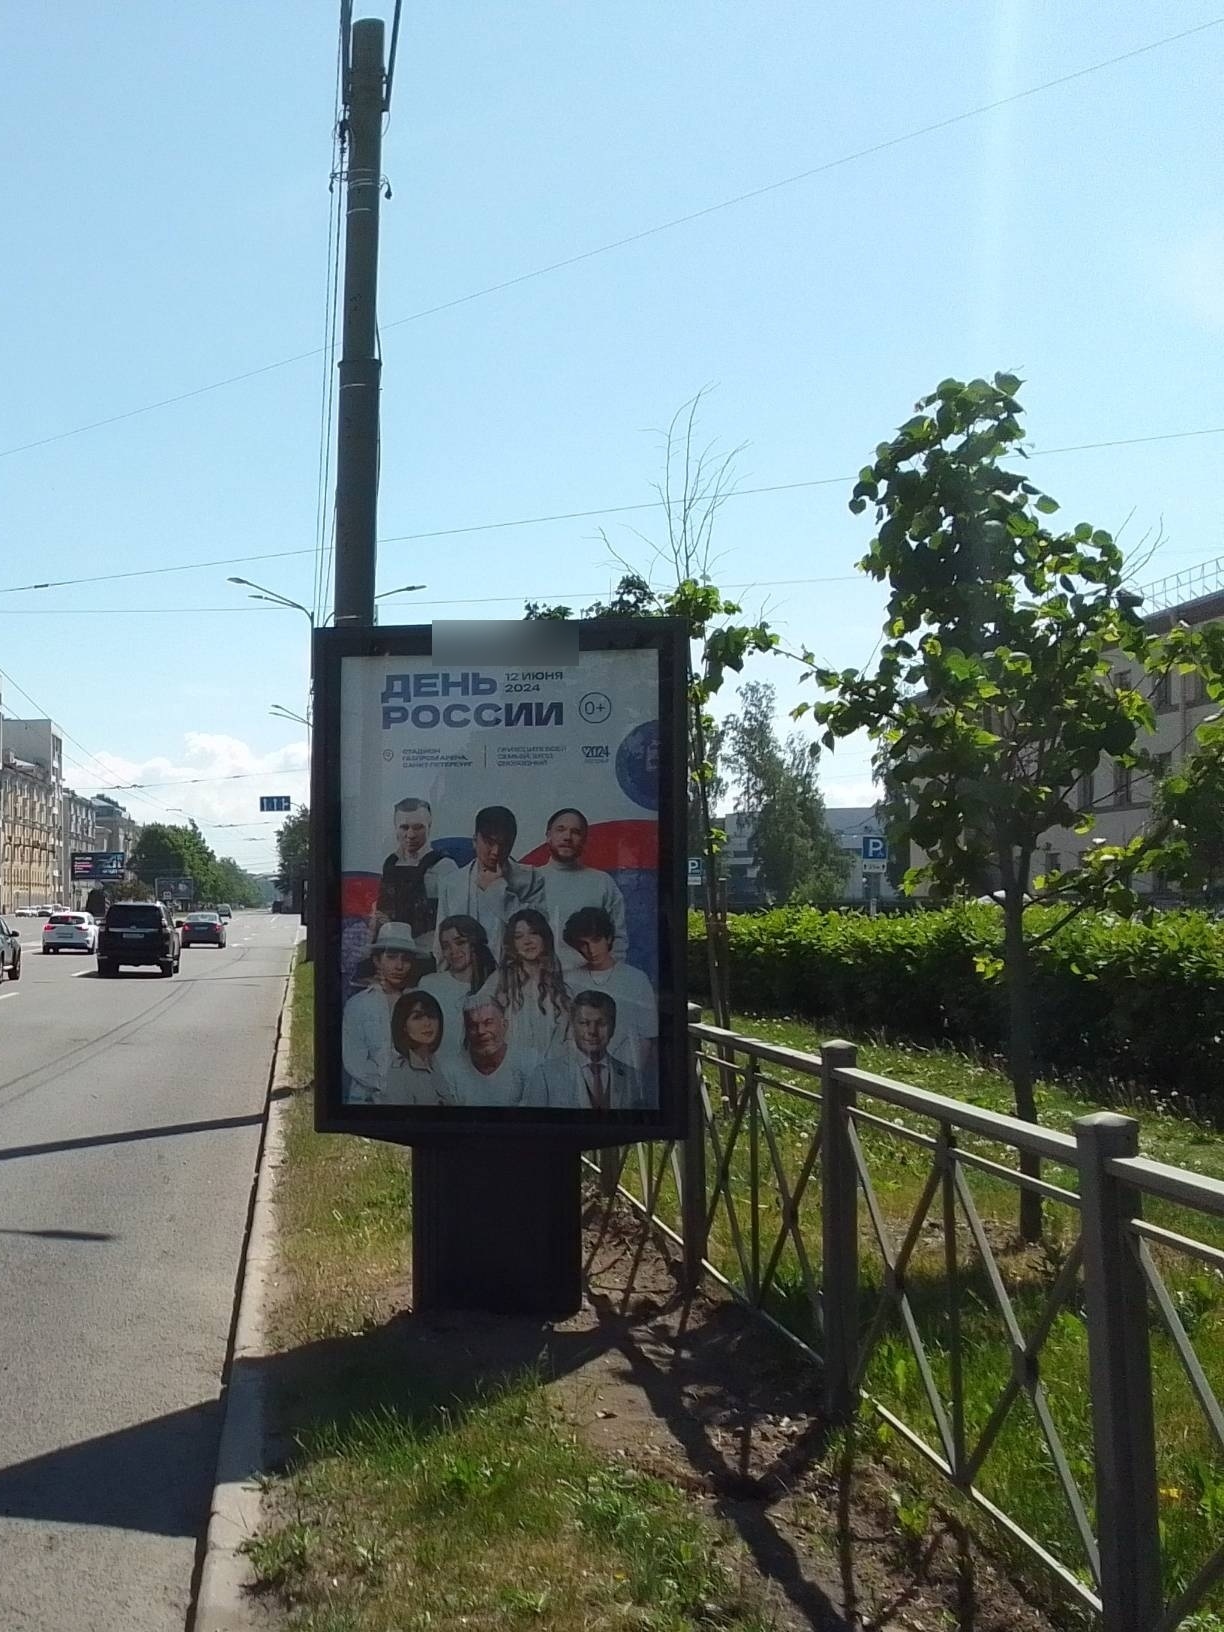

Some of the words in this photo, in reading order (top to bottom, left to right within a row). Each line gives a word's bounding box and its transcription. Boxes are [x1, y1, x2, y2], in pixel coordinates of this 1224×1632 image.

[504, 672, 519, 681] 12
[522, 671, 563, 681] ИЮНЯ
[381, 672, 497, 703] ДЕНЬ
[504, 683, 540, 693] 2024
[381, 701, 563, 730] РОССИИ
[584, 701, 605, 716] 0+
[868, 838, 884, 857] P
